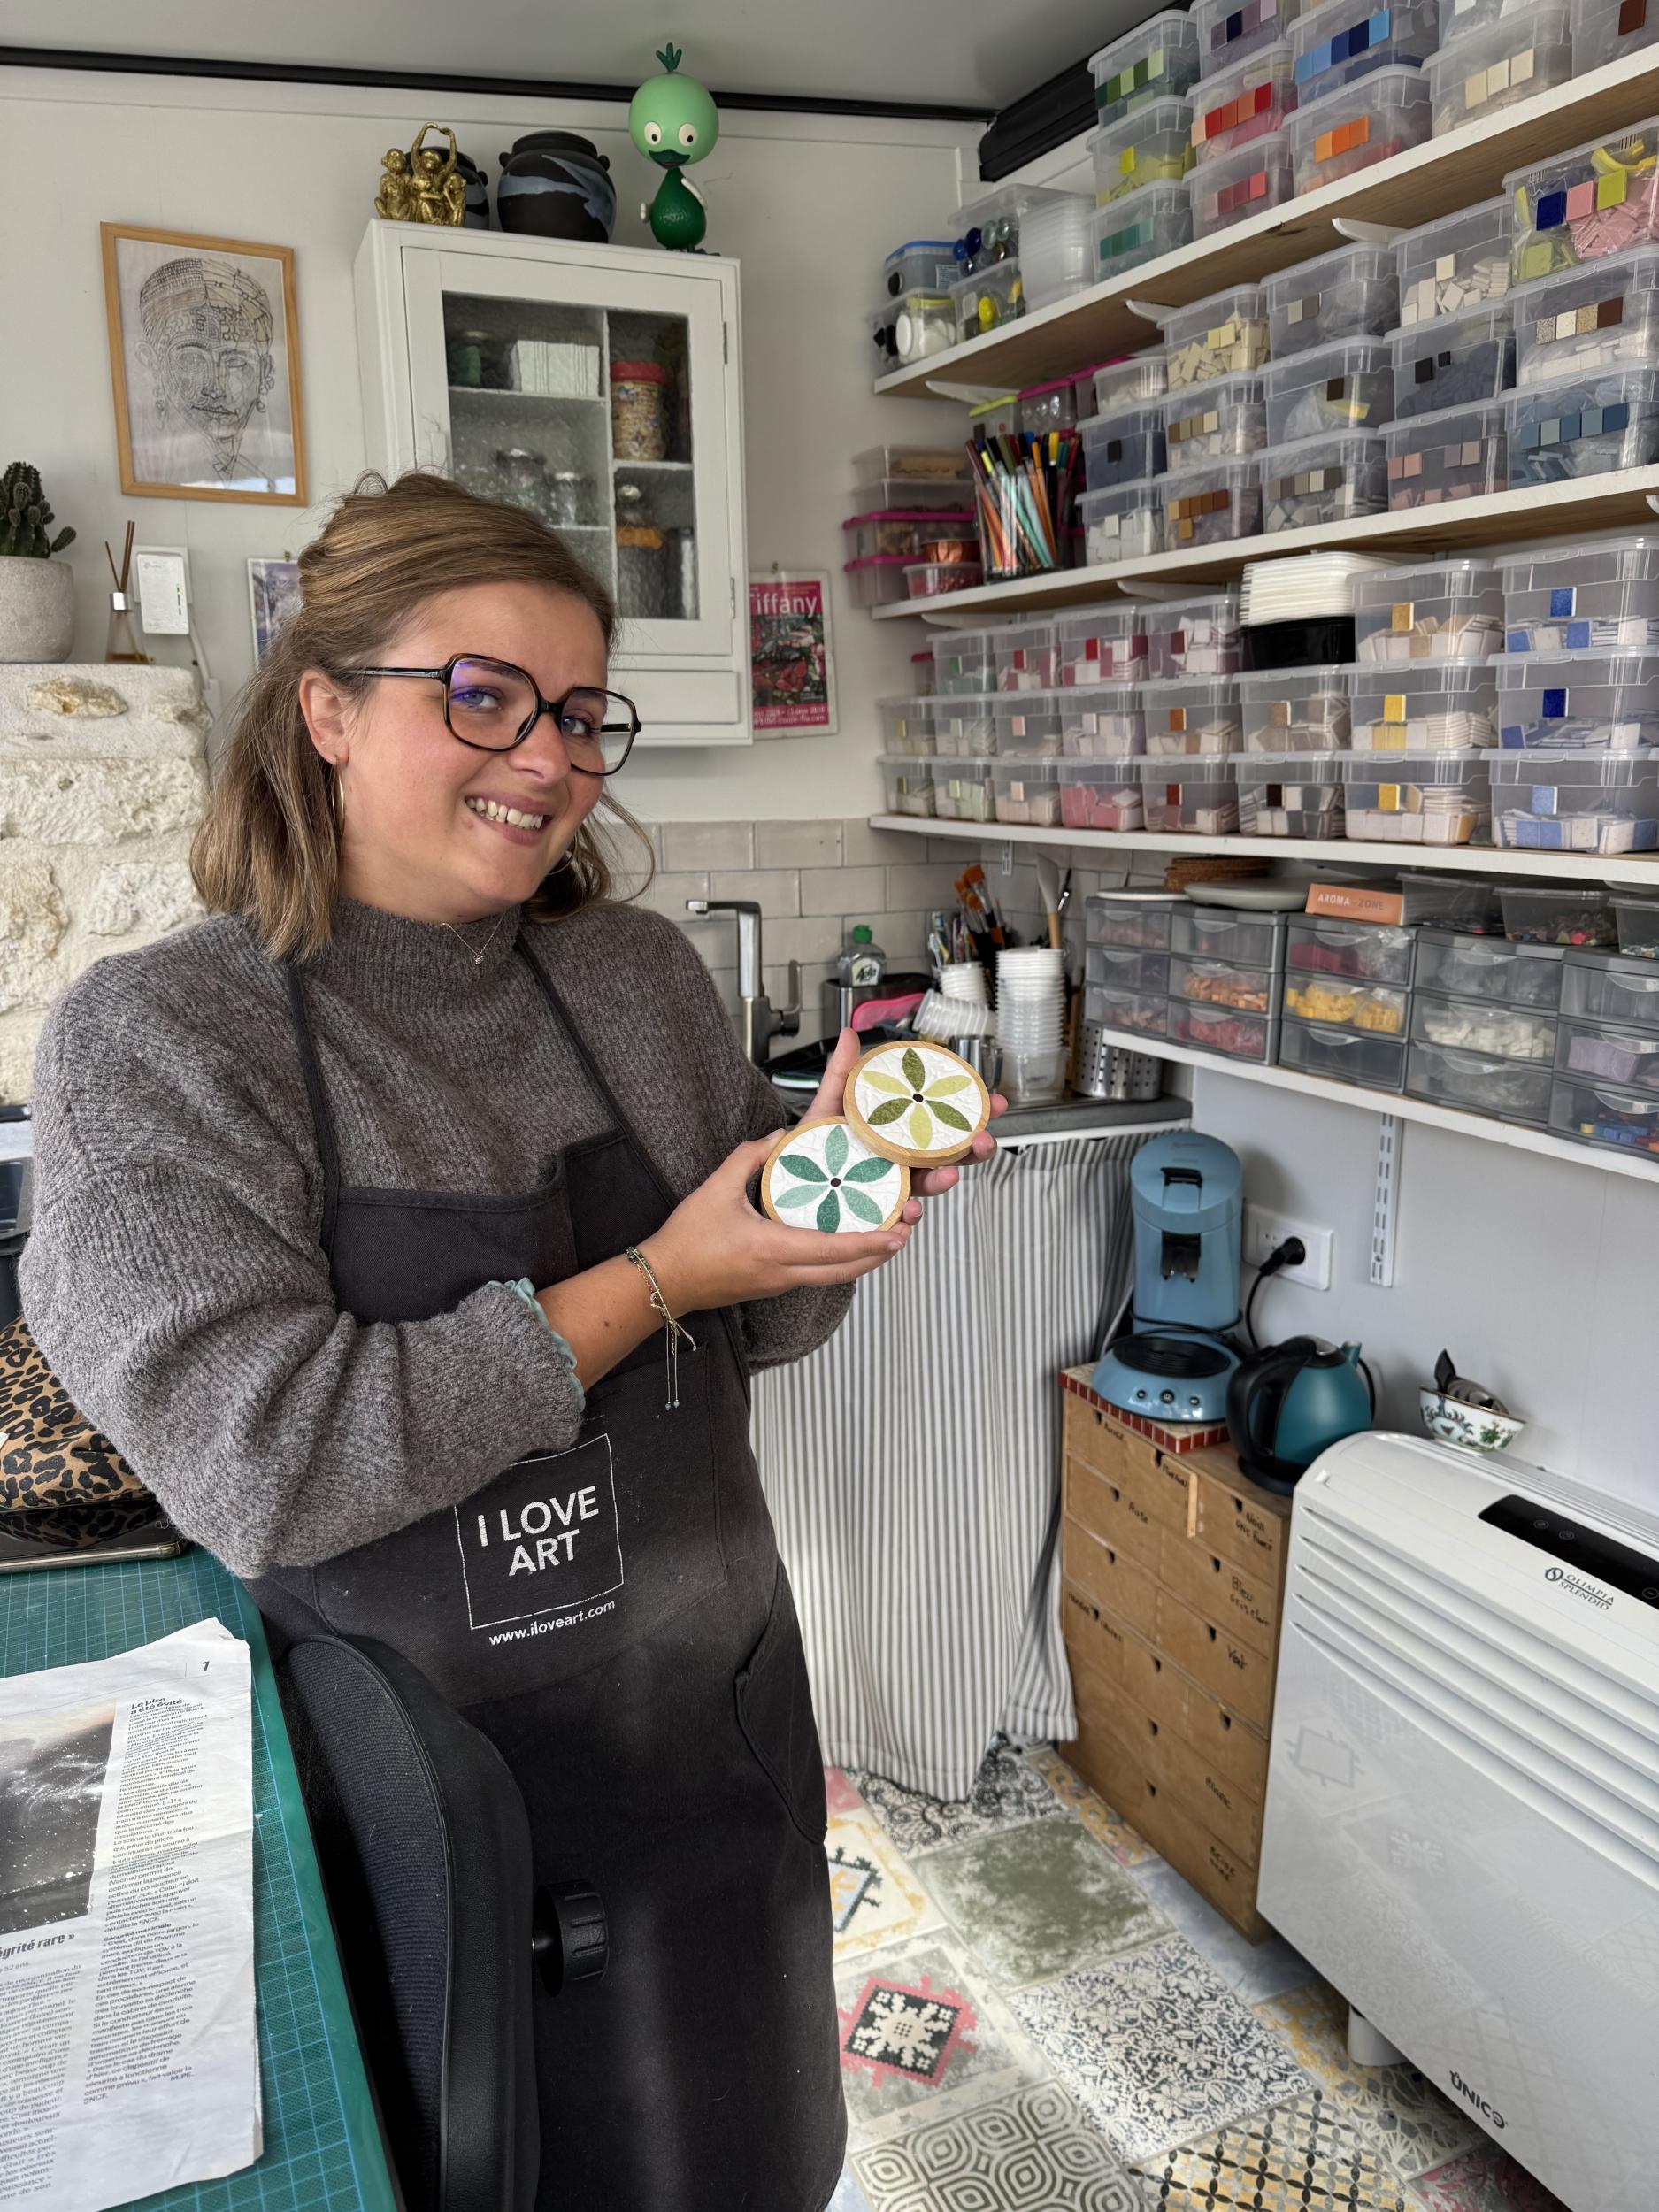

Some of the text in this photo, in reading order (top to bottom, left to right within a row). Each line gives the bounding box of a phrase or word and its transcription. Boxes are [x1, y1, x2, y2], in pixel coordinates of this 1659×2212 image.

[750, 592, 817, 618] iffany
[1317, 893, 1386, 910] AROMA ZONE
[478, 1486, 599, 1547] I LOVE
[508, 1529, 580, 1577] ART
[1558, 1581, 1609, 1610] SPLENDID
[1566, 1574, 1614, 1603] OLIMPIA
[488, 1600, 616, 1646] www.iloveart.com
[202, 1661, 210, 1671] 7
[37, 1934, 65, 1948] rare
